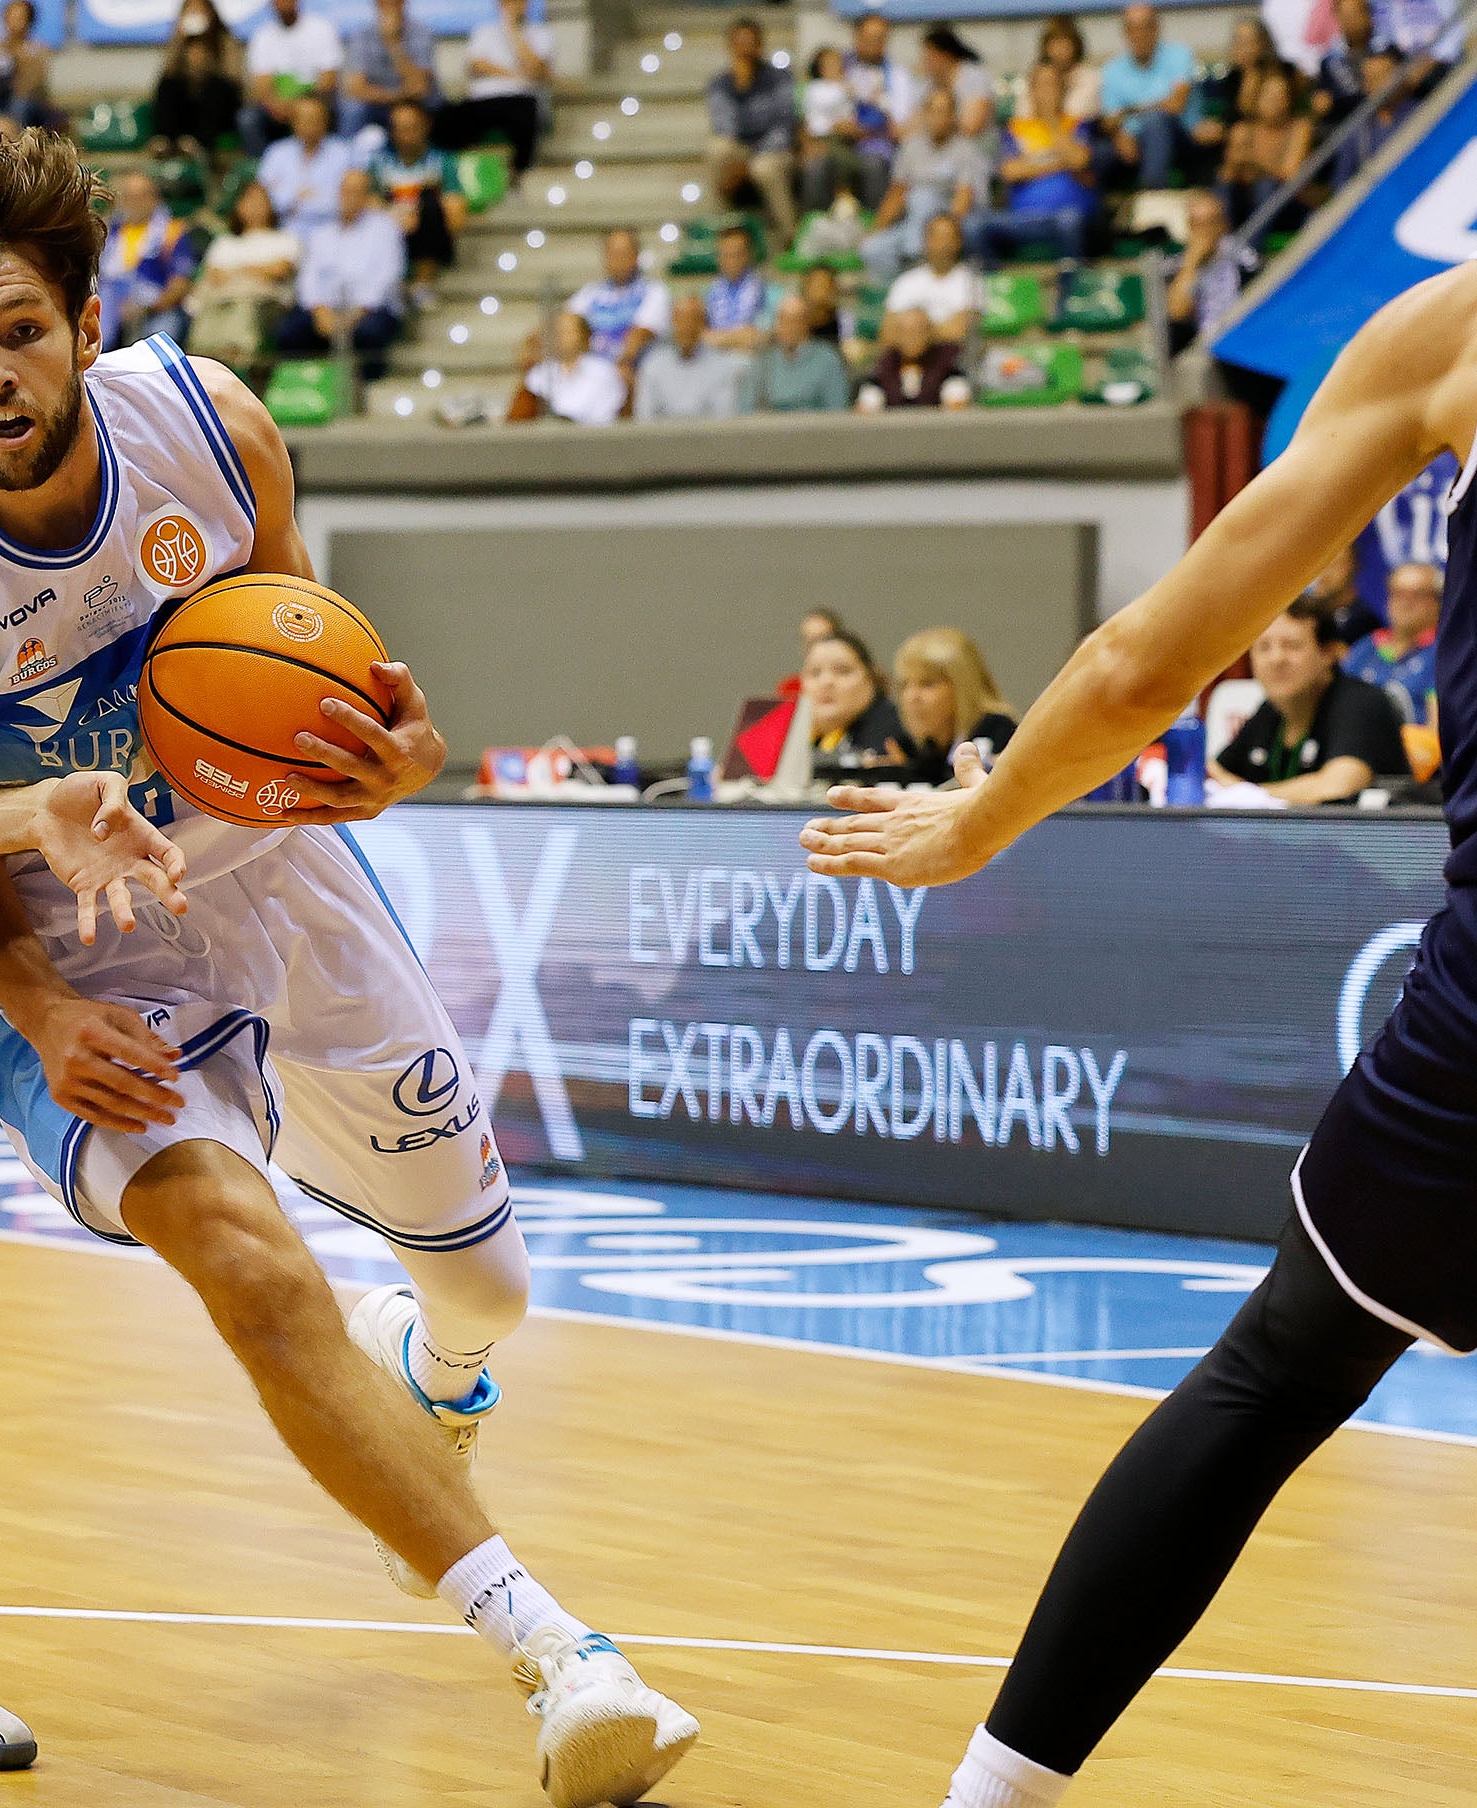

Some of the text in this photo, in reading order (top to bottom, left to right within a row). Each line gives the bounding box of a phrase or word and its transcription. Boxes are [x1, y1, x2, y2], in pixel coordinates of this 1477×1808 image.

[12, 656, 58, 685] BURGOS
[193, 770, 245, 799] PRIMERA
[195, 758, 250, 793] FEB
[628, 866, 928, 976] EVERYDAY
[626, 1016, 1128, 1157] EXTRAORDINARY
[369, 1093, 480, 1154] LEXUS
